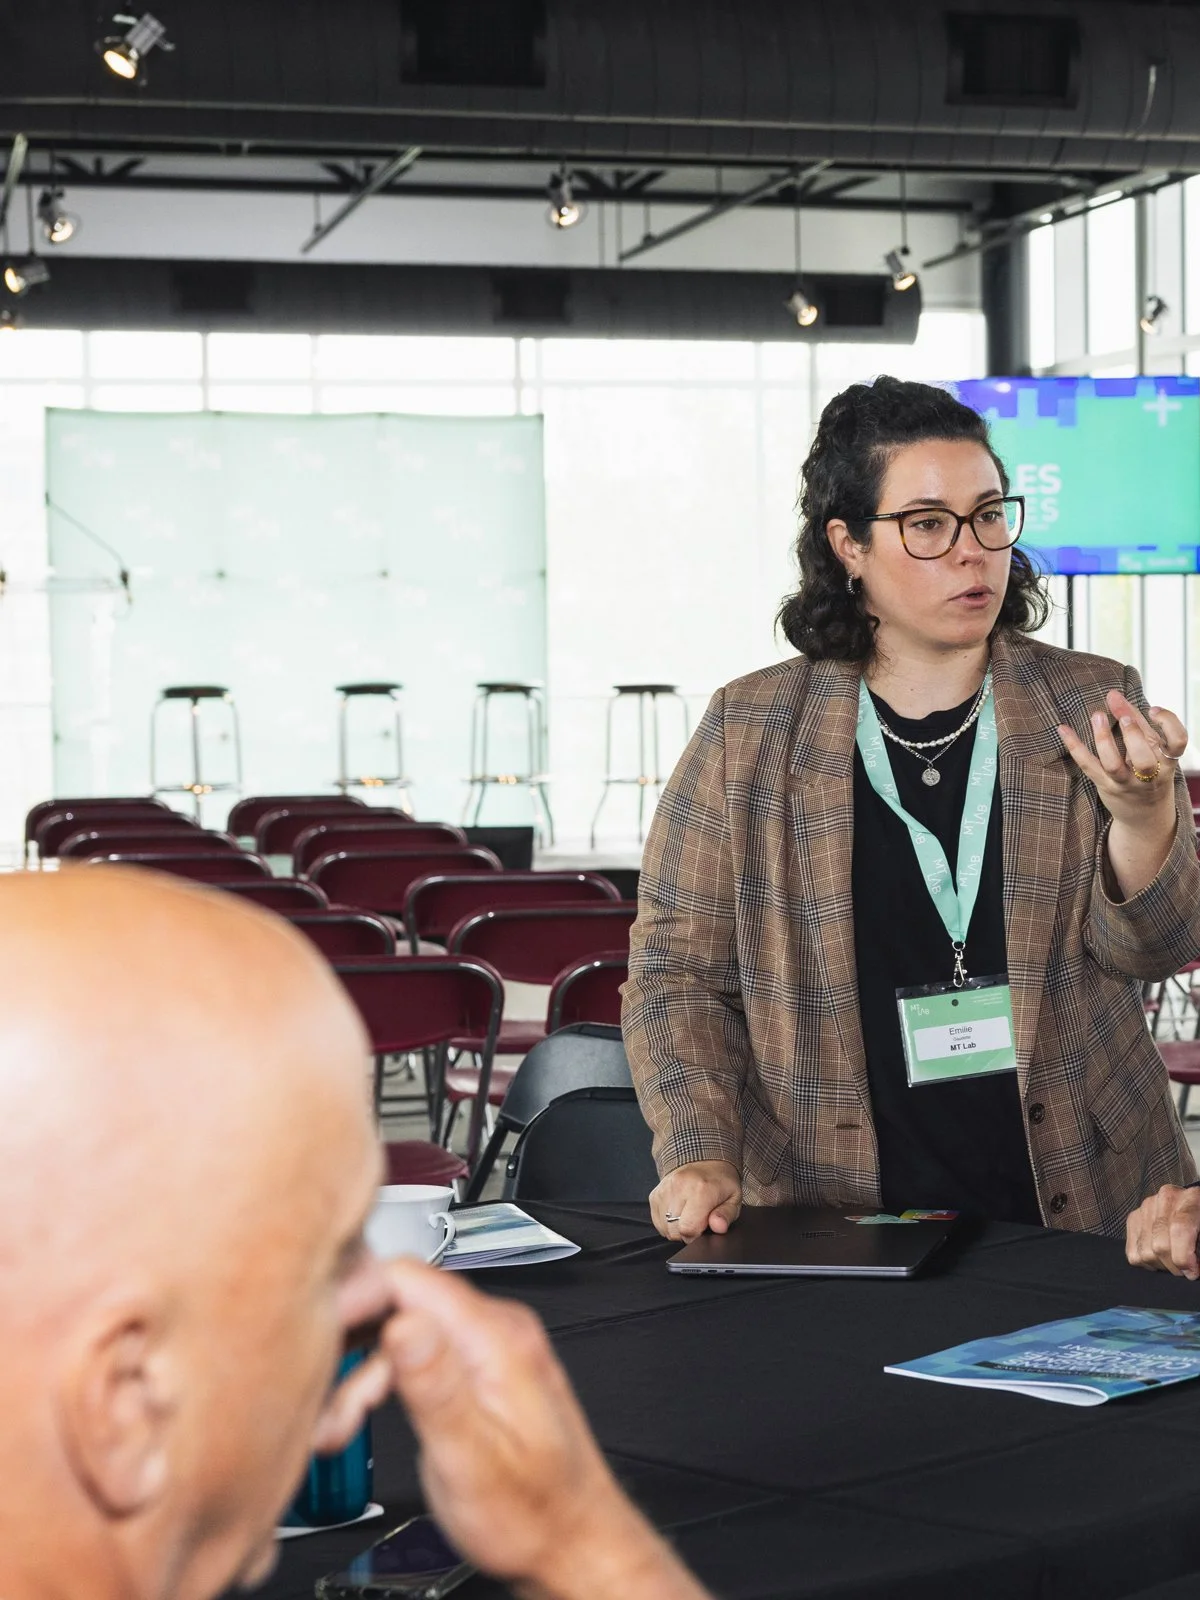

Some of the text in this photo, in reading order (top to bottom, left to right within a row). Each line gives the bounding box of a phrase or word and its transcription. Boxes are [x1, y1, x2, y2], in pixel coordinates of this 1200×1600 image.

[979, 724, 991, 740] MT
[869, 735, 882, 751] MT
[863, 749, 877, 768] LAB
[983, 757, 995, 776] LAB
[971, 770, 982, 786] MT
[976, 804, 987, 824] LAB
[963, 819, 974, 835] MT
[933, 858, 948, 875] MT
[969, 855, 981, 876] LAB
[927, 872, 942, 894] LAB
[959, 870, 969, 887] MT
[949, 1026, 973, 1035] Emilie
[950, 1042, 977, 1051] MT Lab
[1057, 1350, 1192, 1370] CULTURE
